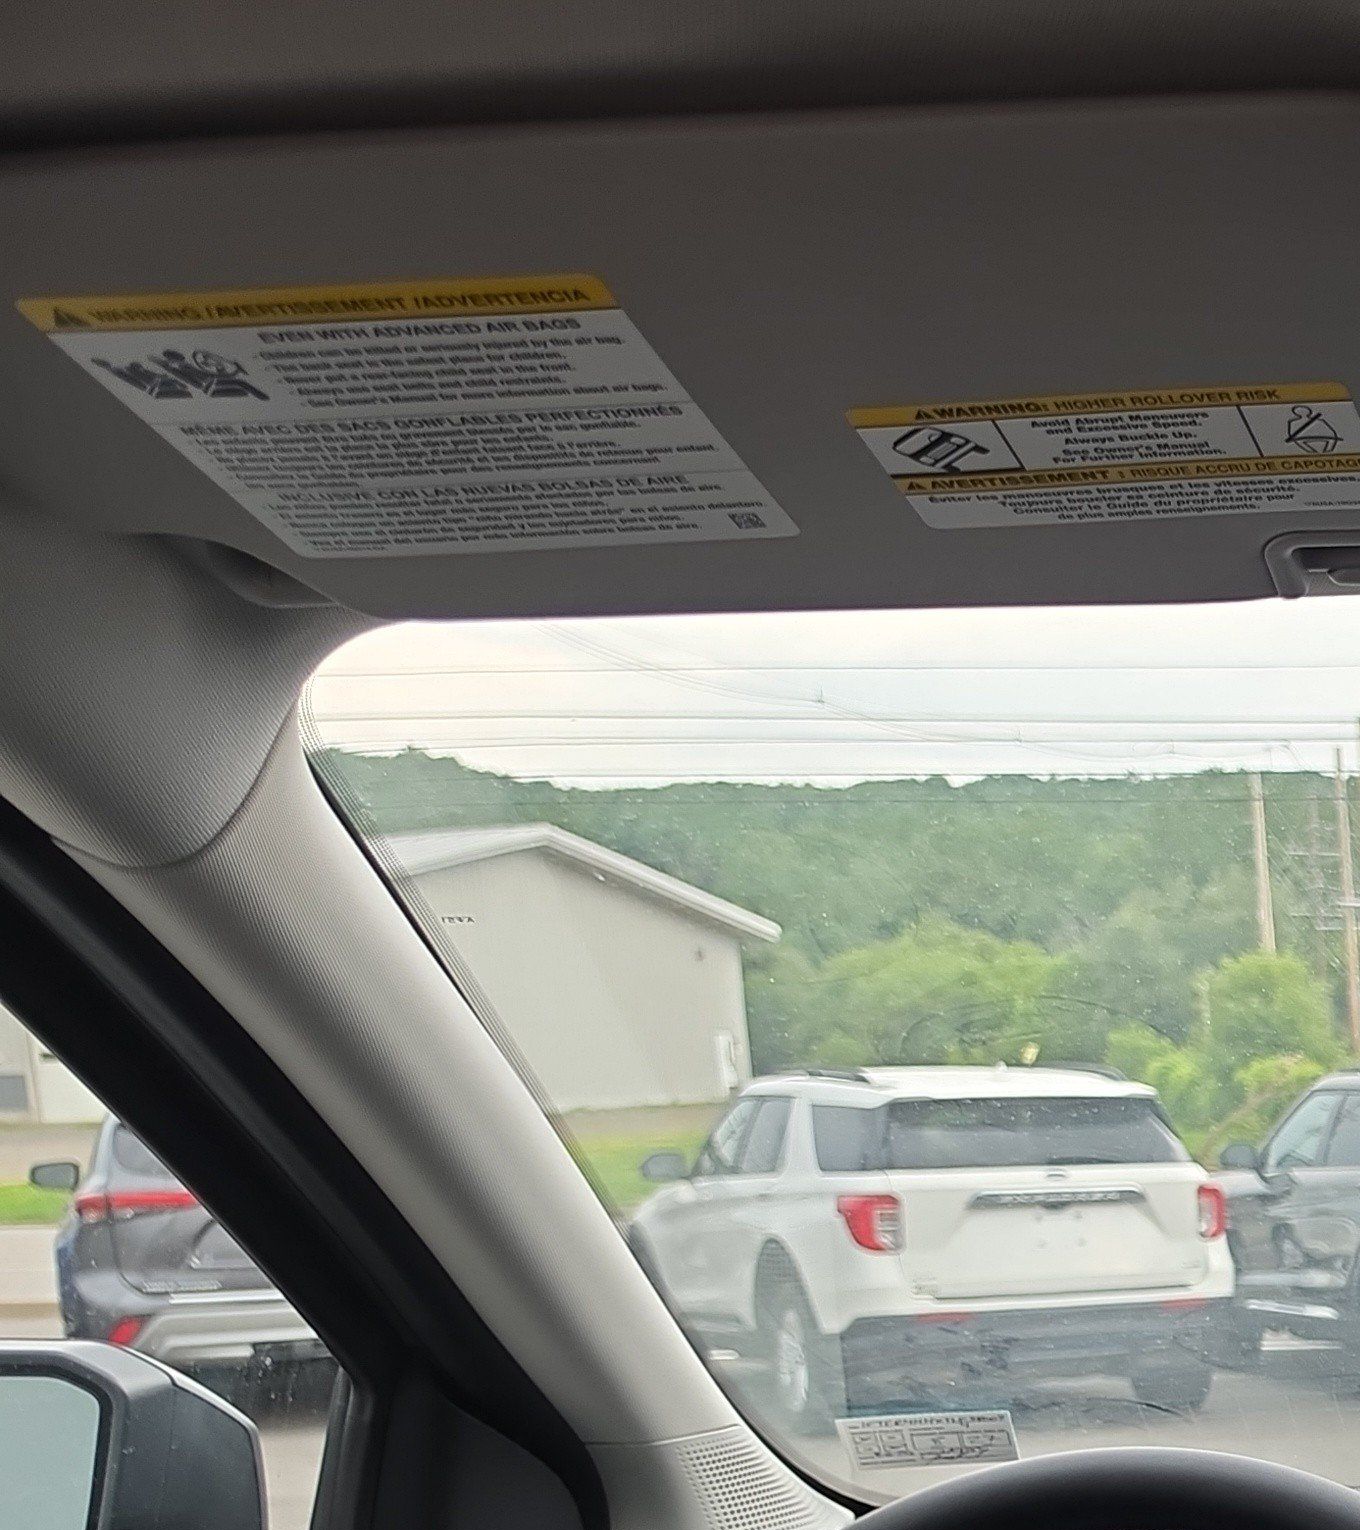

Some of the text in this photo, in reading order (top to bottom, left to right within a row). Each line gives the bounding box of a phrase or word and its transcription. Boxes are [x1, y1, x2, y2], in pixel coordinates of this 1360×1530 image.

[257, 317, 582, 344] EVEN WITH ADVANCED AIR BAGS
[934, 389, 1281, 419] WARNING: HIGHER ROLLOVER RISK
[338, 419, 391, 432] SACS
[1030, 411, 1209, 429] Avoid Abrupt Maneuvers
[1045, 418, 1203, 436] and Excessive Speed.
[1064, 430, 1198, 446] Always Buckle Up.
[1052, 448, 1227, 465] For Further Information.
[1062, 440, 1210, 457] See Owner's Manual
[931, 470, 1110, 490] AVERTISSEMENT
[1130, 465, 1192, 478] RISQUE
[1195, 462, 1251, 475] ACCRU
[1255, 461, 1276, 472] DE
[377, 487, 418, 500] CON
[421, 486, 459, 498] LAS
[462, 482, 534, 497] NUEVAS
[538, 479, 613, 493] BOLSAS
[616, 477, 643, 489] DE
[646, 474, 689, 487] AIRE
